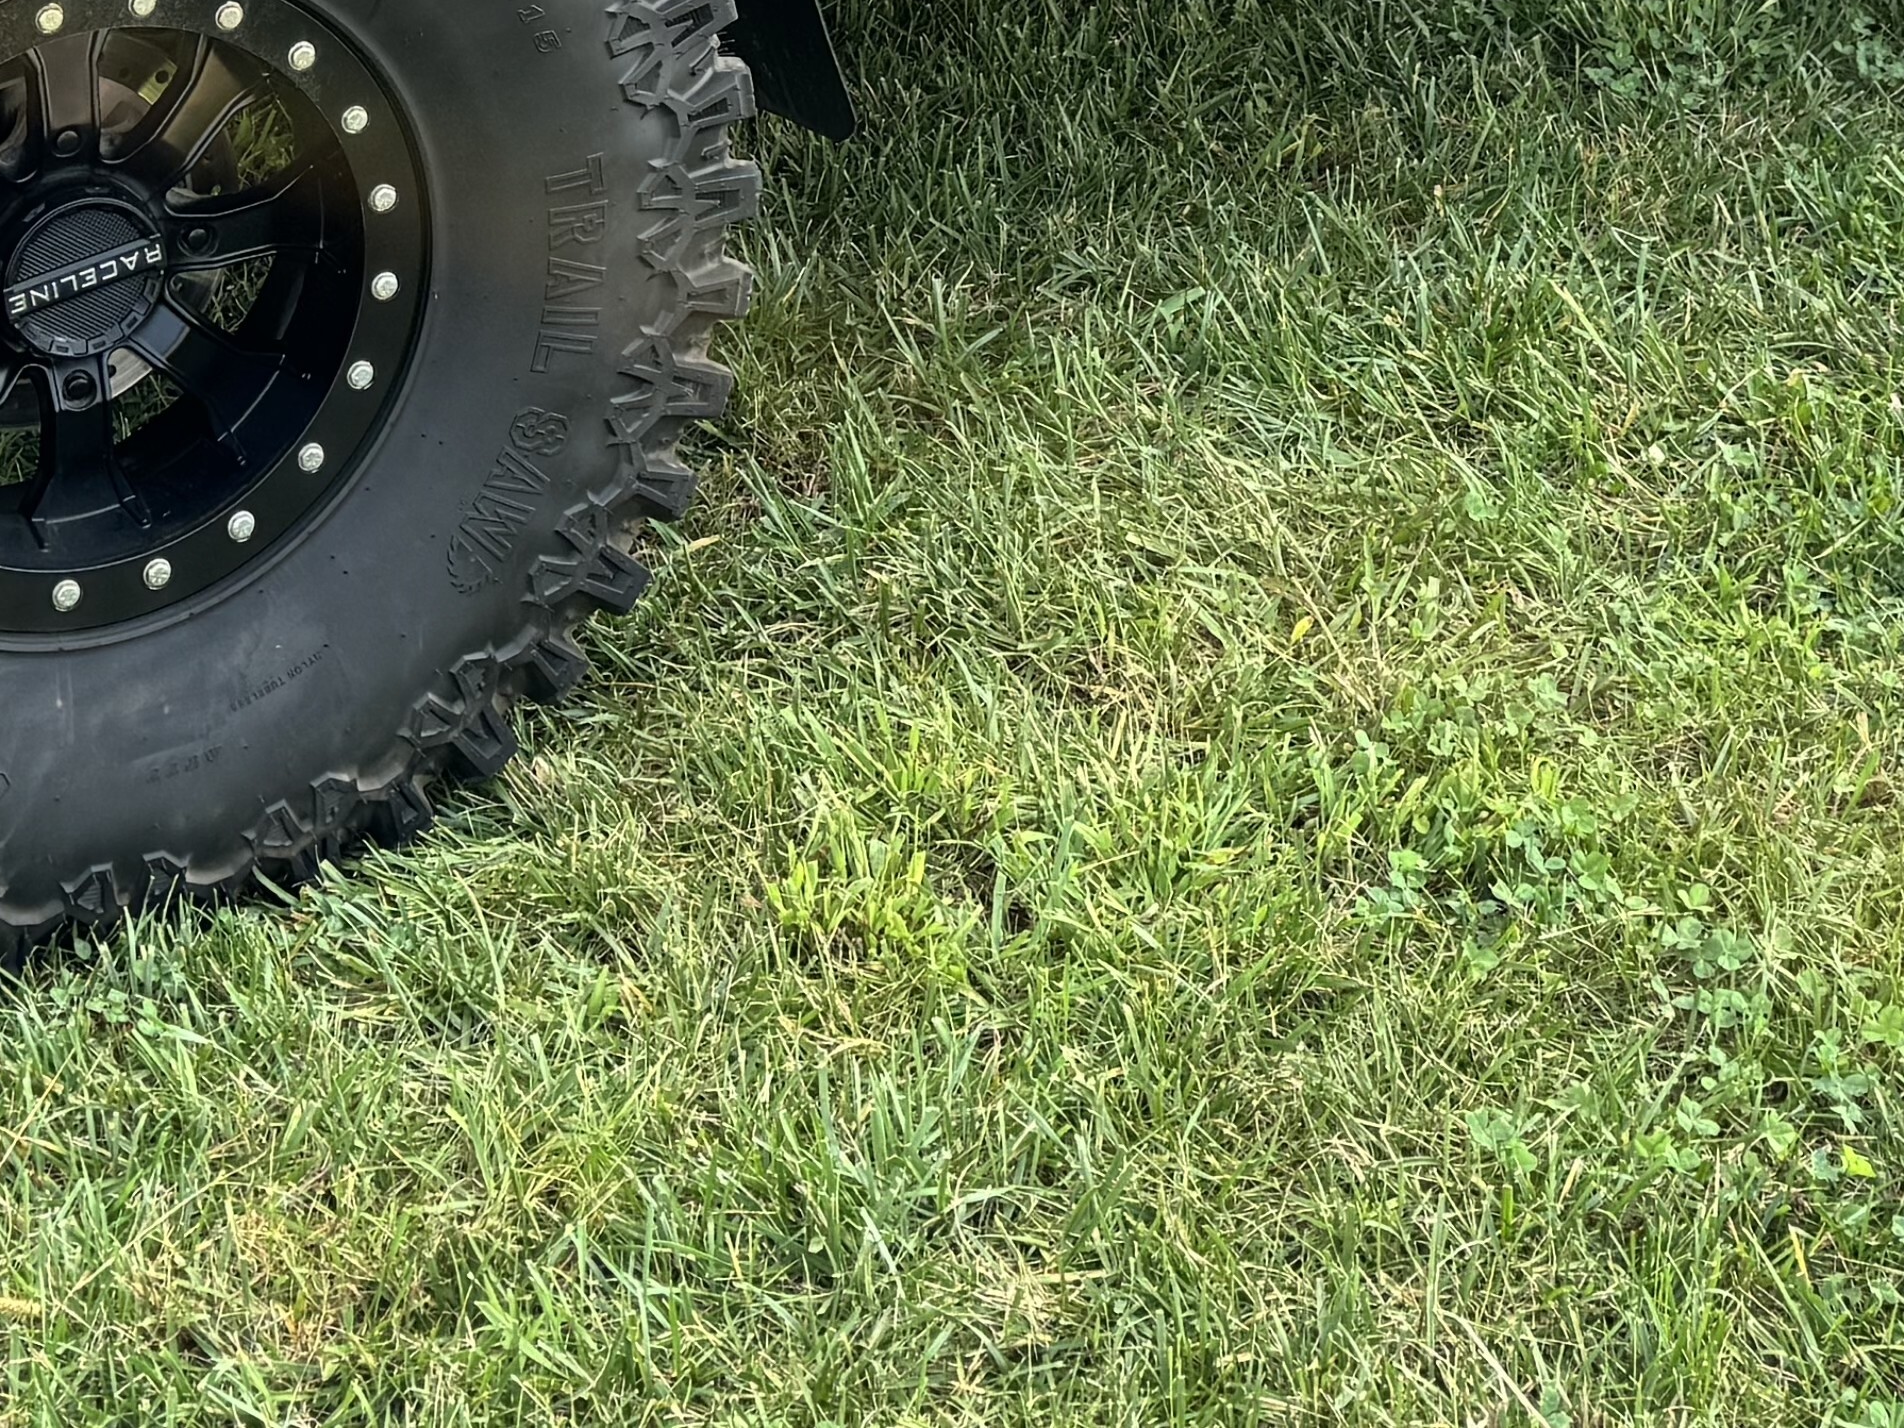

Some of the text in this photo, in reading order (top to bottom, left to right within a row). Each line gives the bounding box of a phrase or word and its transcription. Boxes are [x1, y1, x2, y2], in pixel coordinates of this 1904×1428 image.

[8, 243, 163, 315] RACELINE
[458, 151, 609, 563] TRAIL SAW
